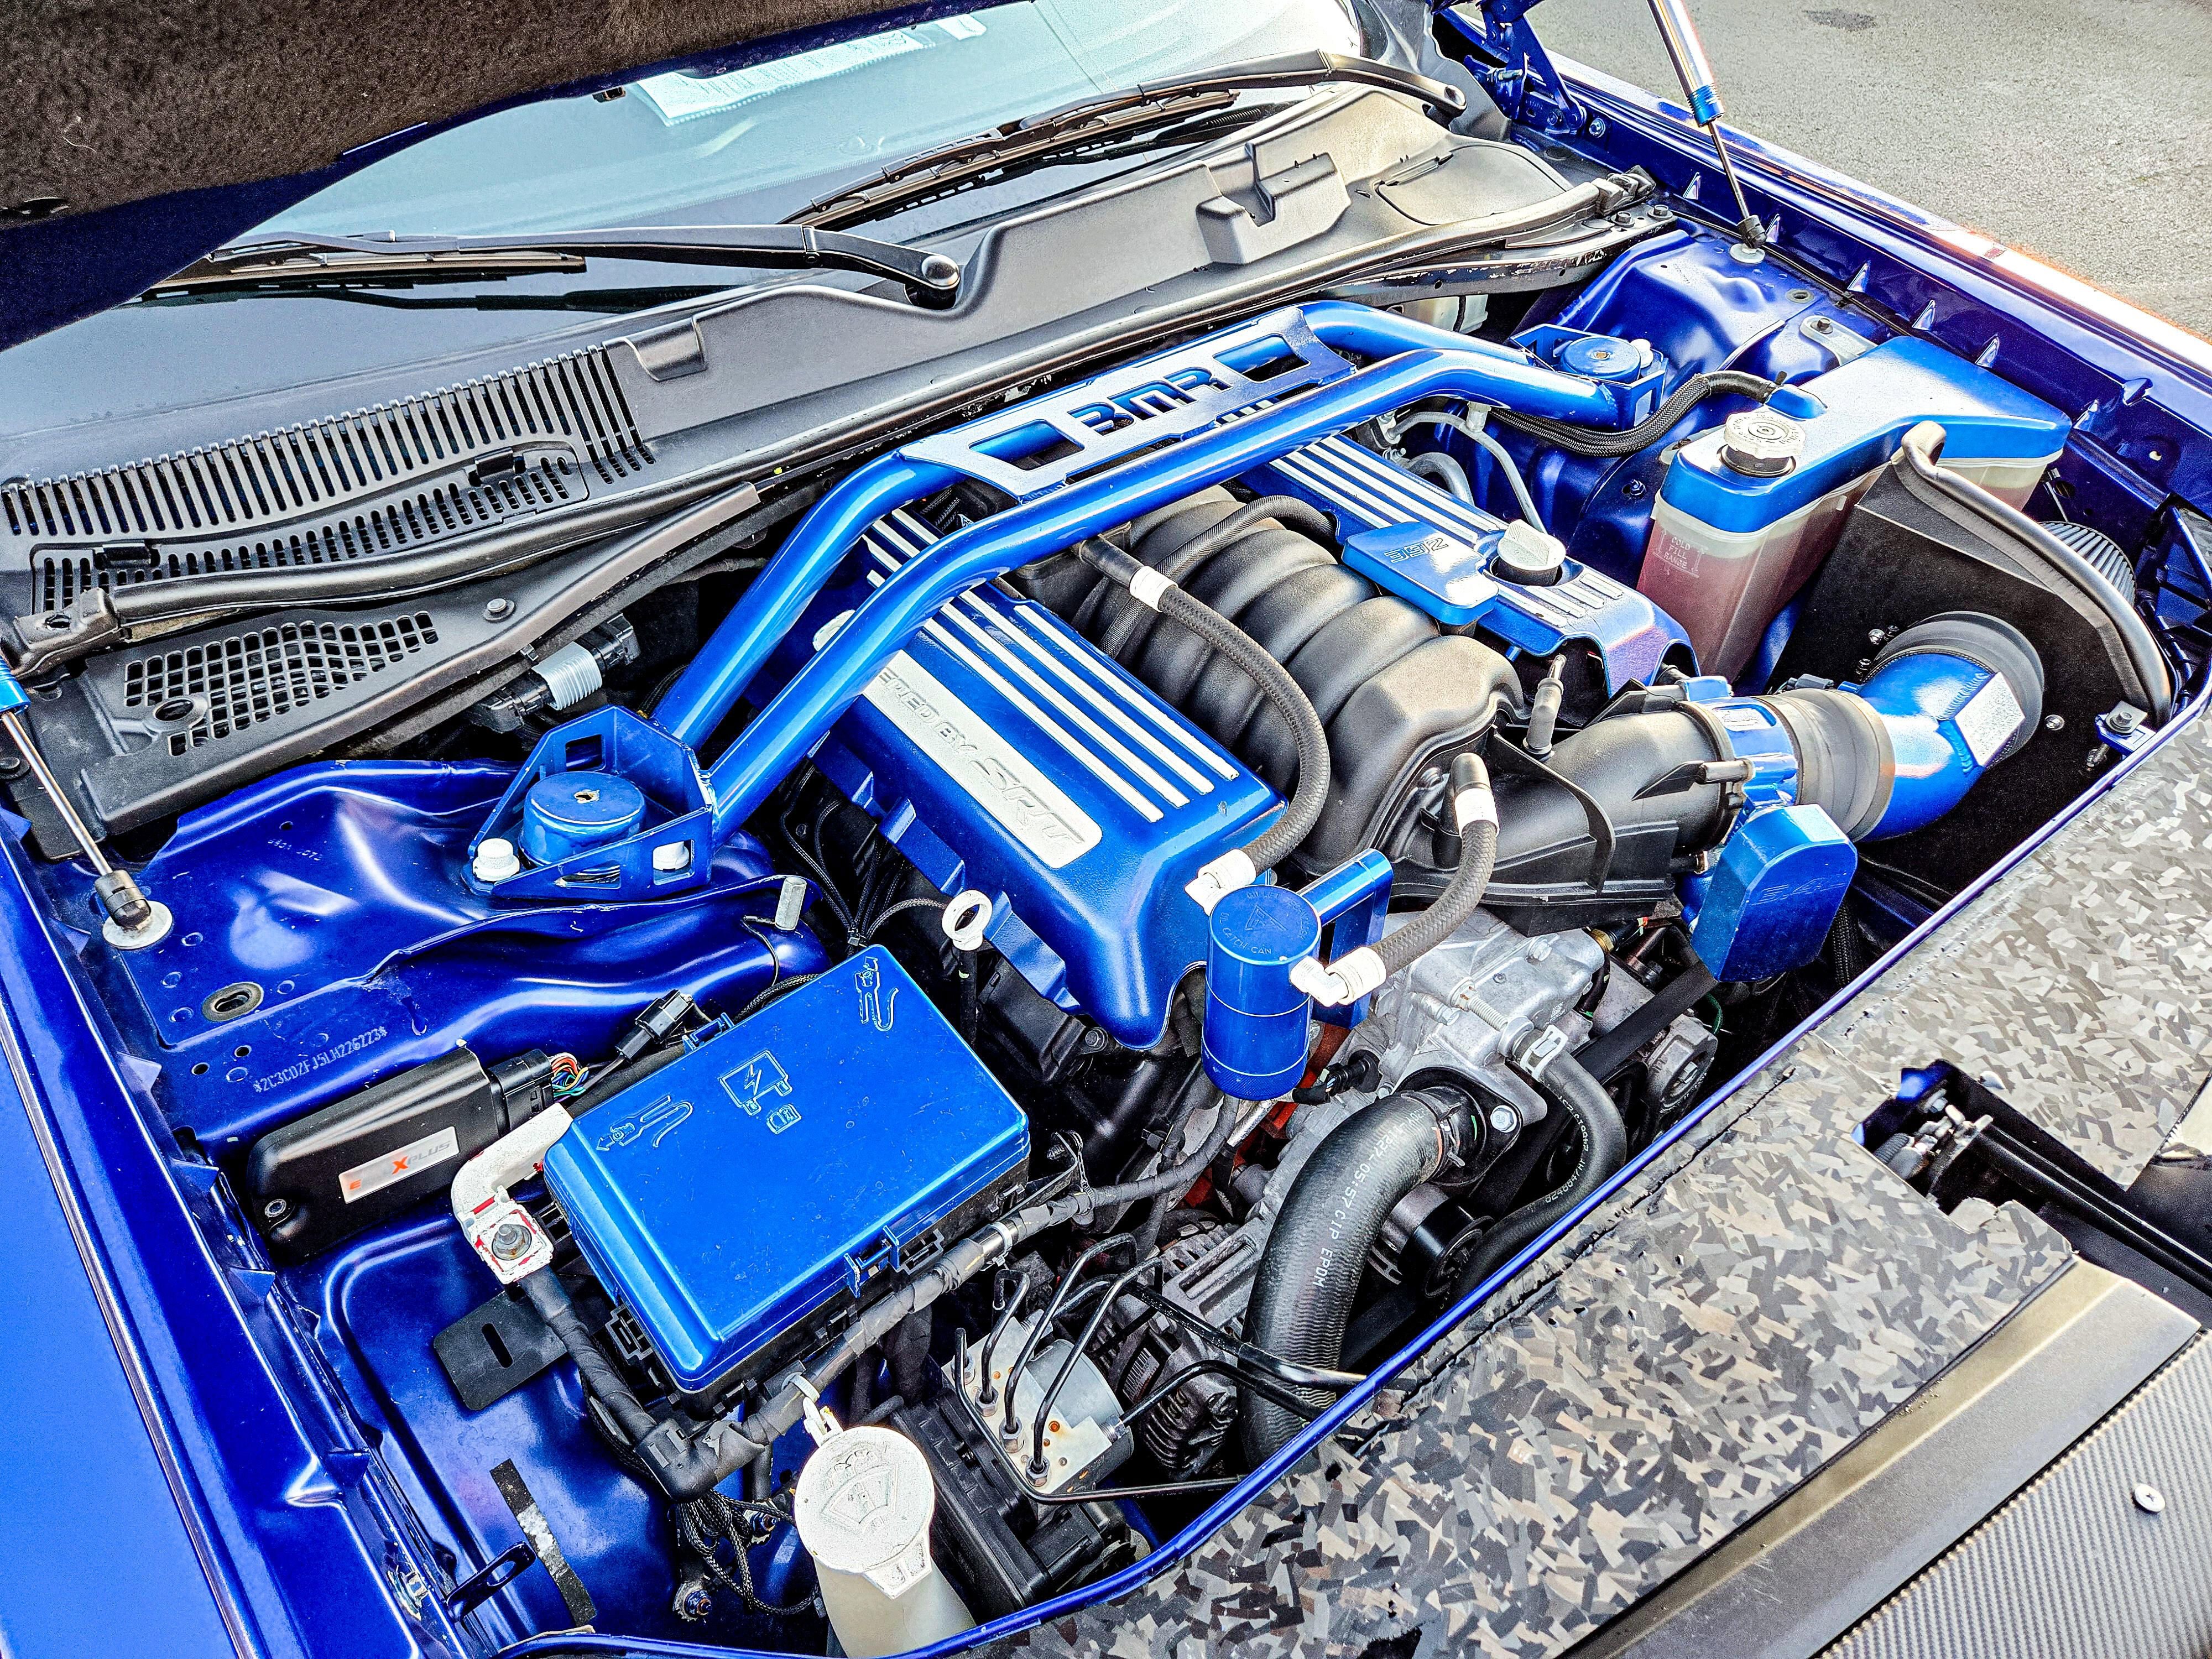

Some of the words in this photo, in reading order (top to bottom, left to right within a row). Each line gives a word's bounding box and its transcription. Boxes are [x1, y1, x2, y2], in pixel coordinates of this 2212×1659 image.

[1066, 366, 1234, 436] BMR
[1384, 537, 1449, 563] 392
[1668, 544, 1687, 560] FILL
[1671, 536, 1691, 550] COLD
[1663, 551, 1688, 569] RANGE
[935, 721, 978, 753] BY
[968, 757, 1086, 844] SRT
[1246, 890, 1282, 899] BILLET
[1250, 946, 1272, 954] CAN
[1329, 1209, 1346, 1240] CIP
[1312, 1246, 1333, 1288] EPDM
